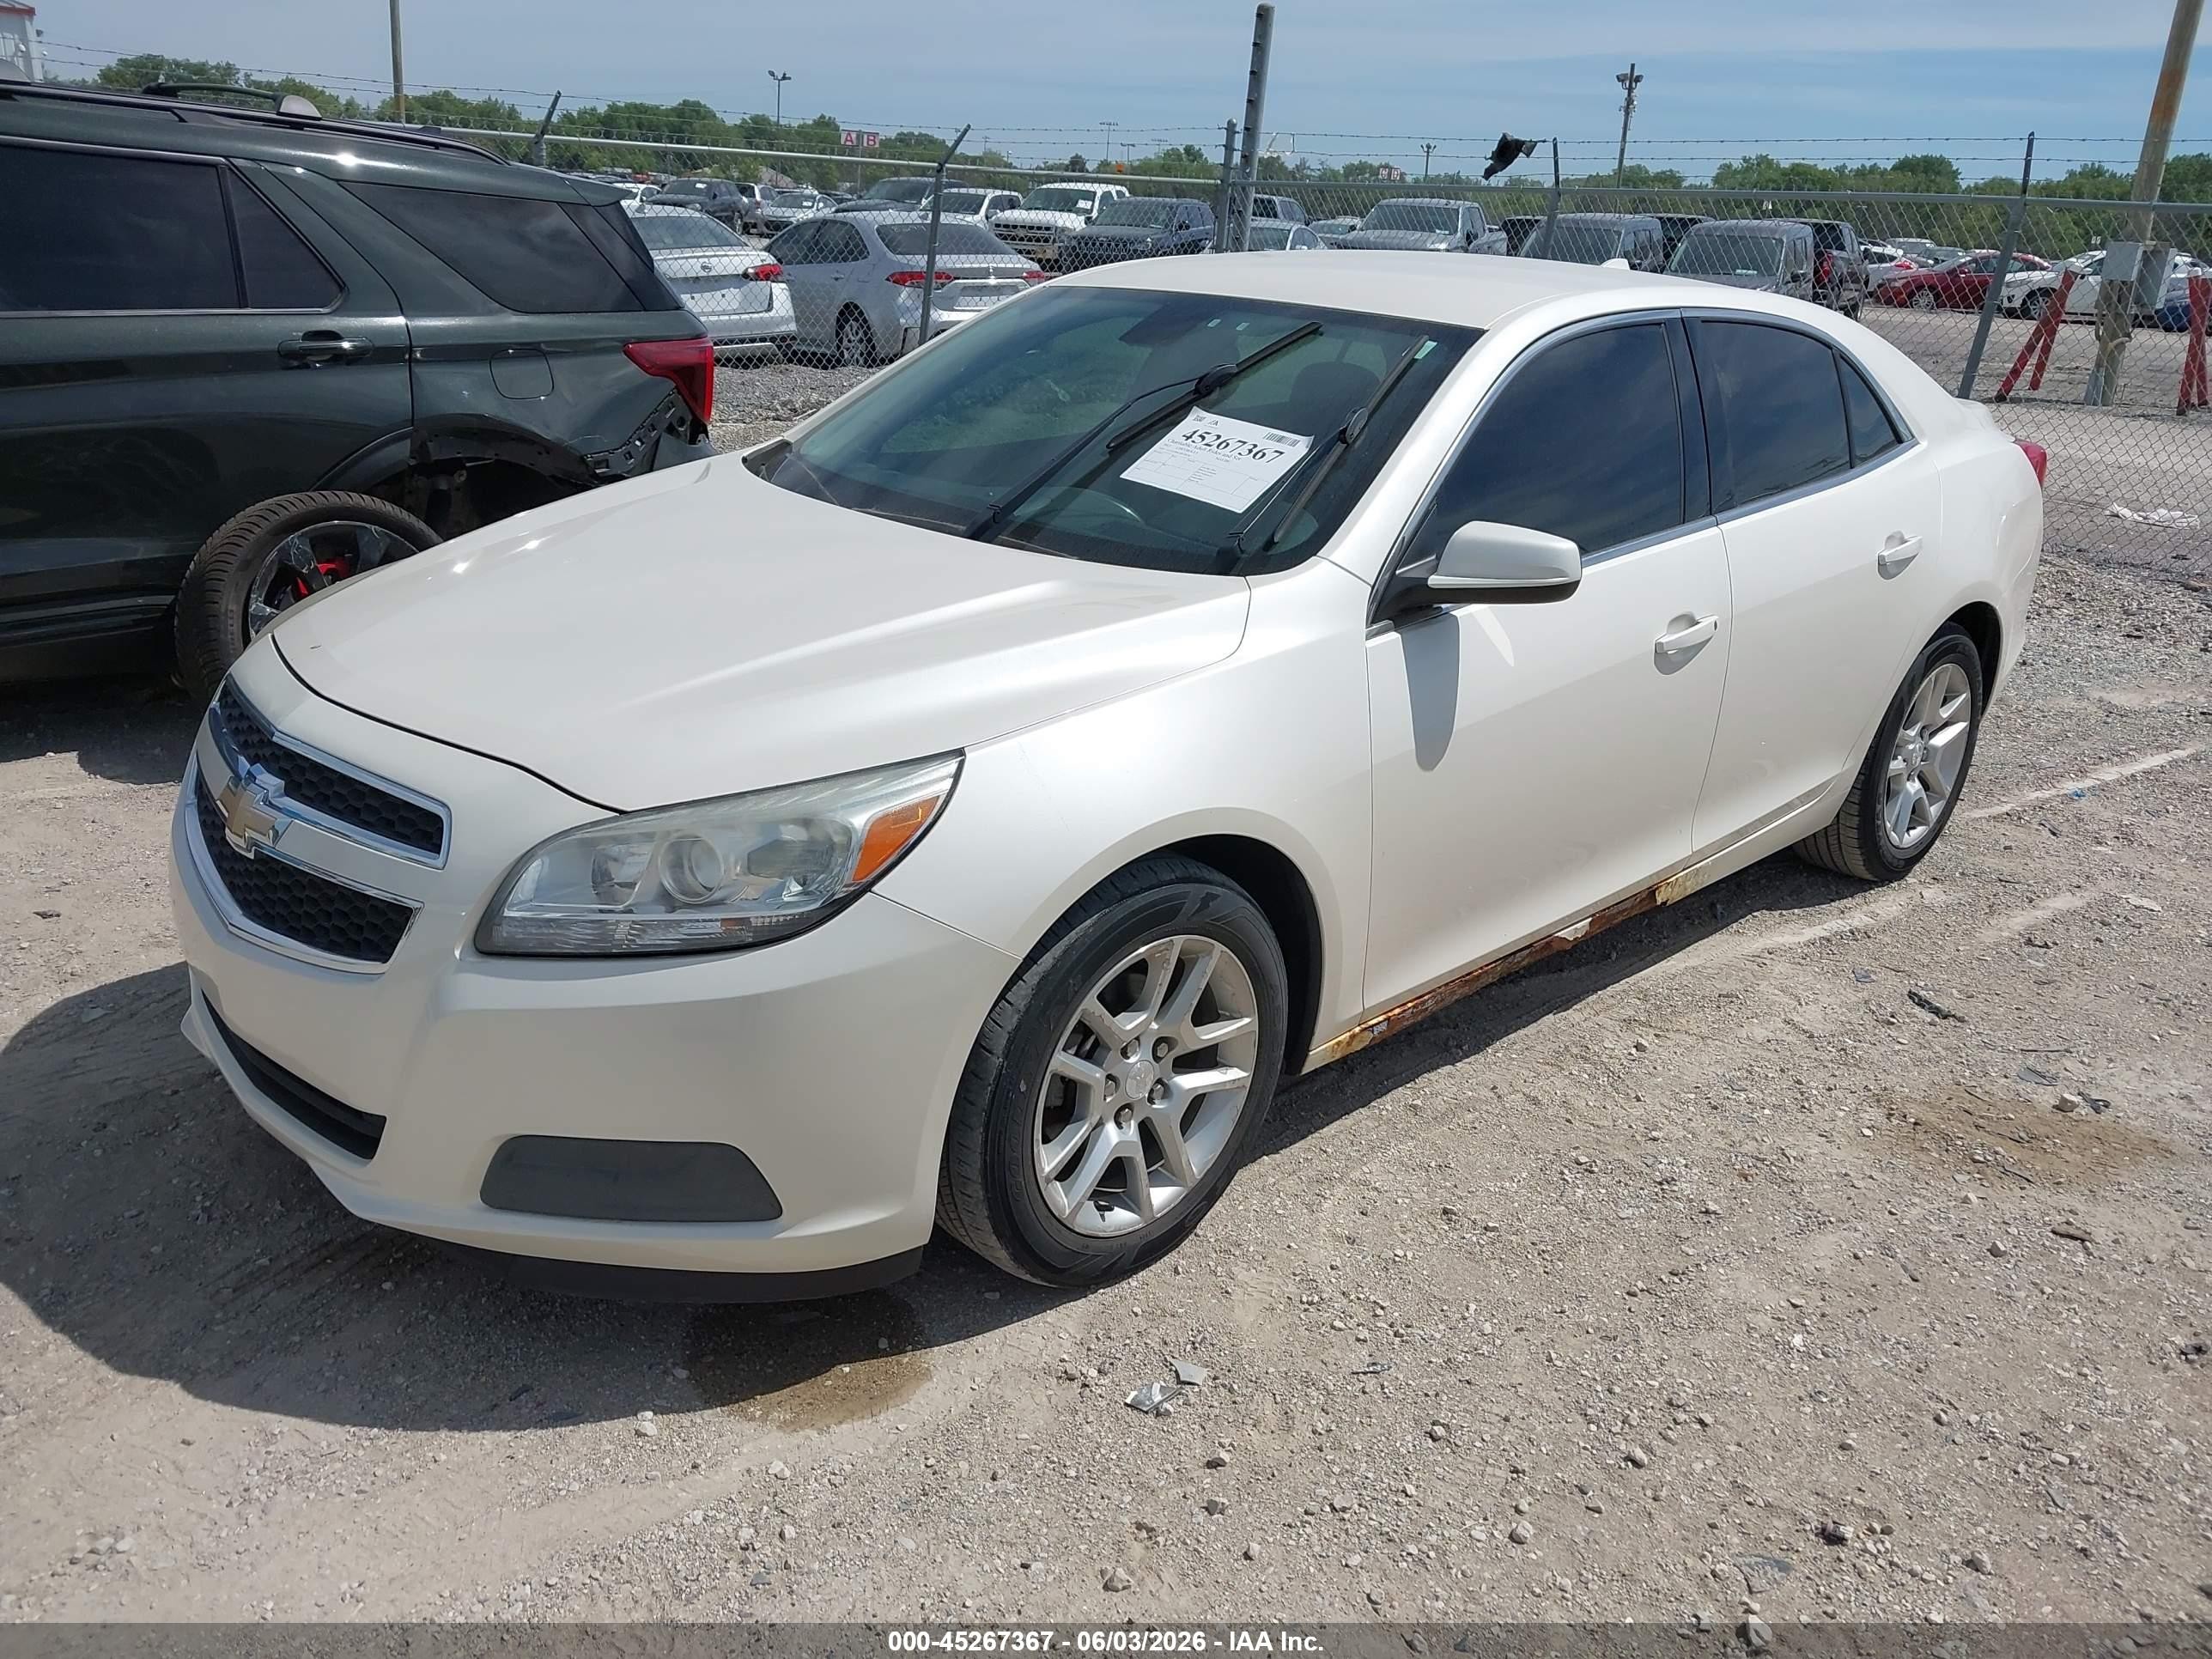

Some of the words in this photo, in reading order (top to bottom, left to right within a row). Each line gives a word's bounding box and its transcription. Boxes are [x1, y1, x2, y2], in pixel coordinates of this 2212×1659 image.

[844, 132, 854, 144] A
[866, 135, 876, 146] B
[1182, 428, 1285, 463] 45267367
